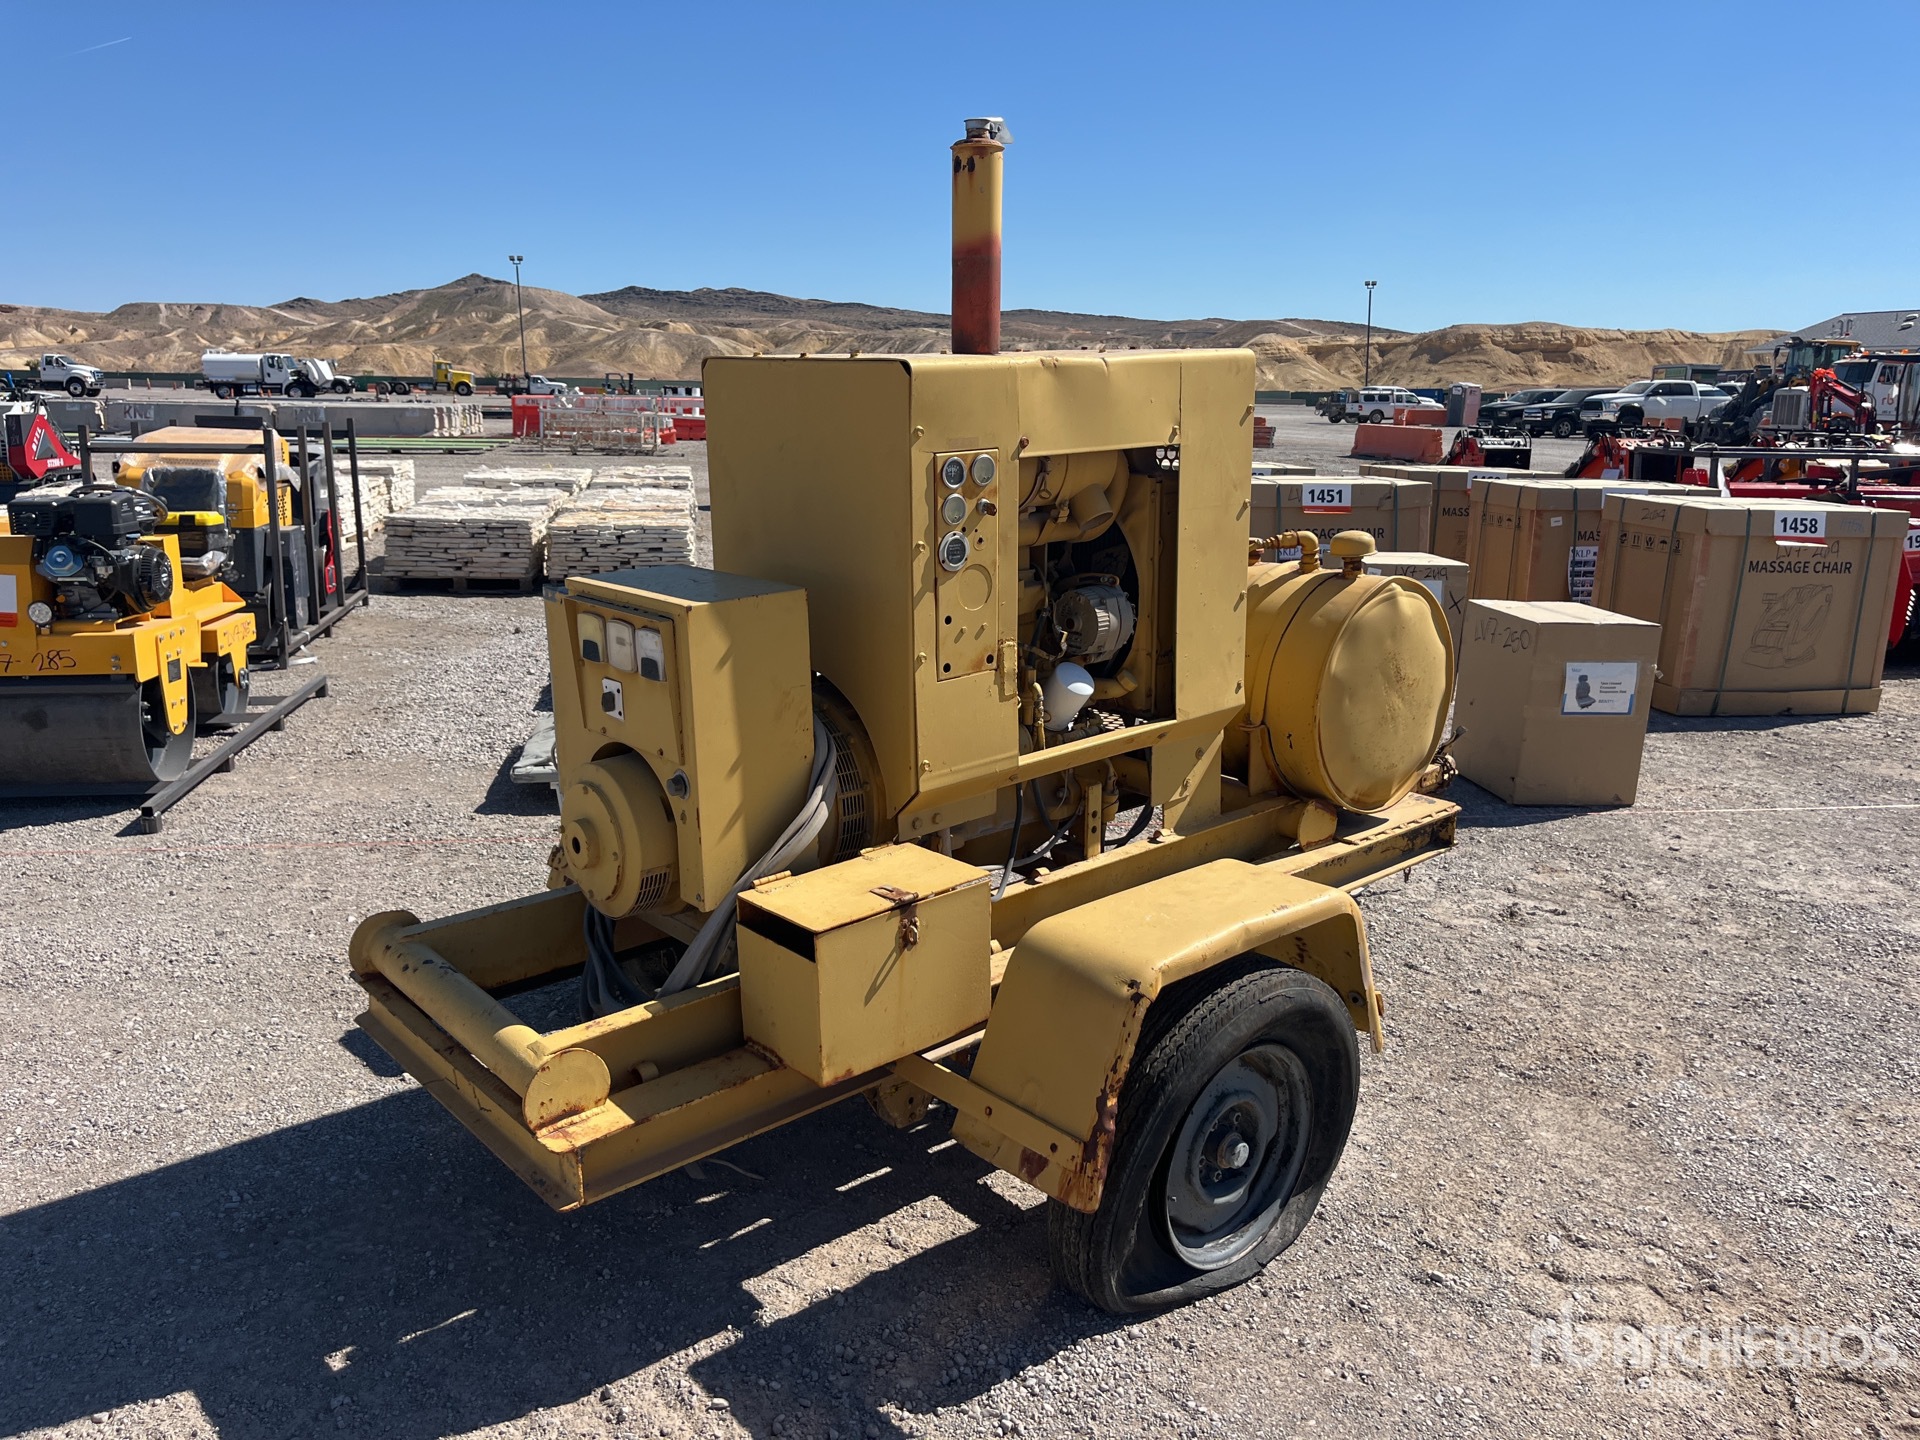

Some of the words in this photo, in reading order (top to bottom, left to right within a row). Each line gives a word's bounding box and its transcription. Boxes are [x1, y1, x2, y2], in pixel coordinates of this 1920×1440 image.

[1308, 489, 1343, 503] 1451
[1780, 517, 1818, 534] 1458
[1748, 560, 1810, 574] MASSAGE
[1813, 561, 1852, 574] CHAIR
